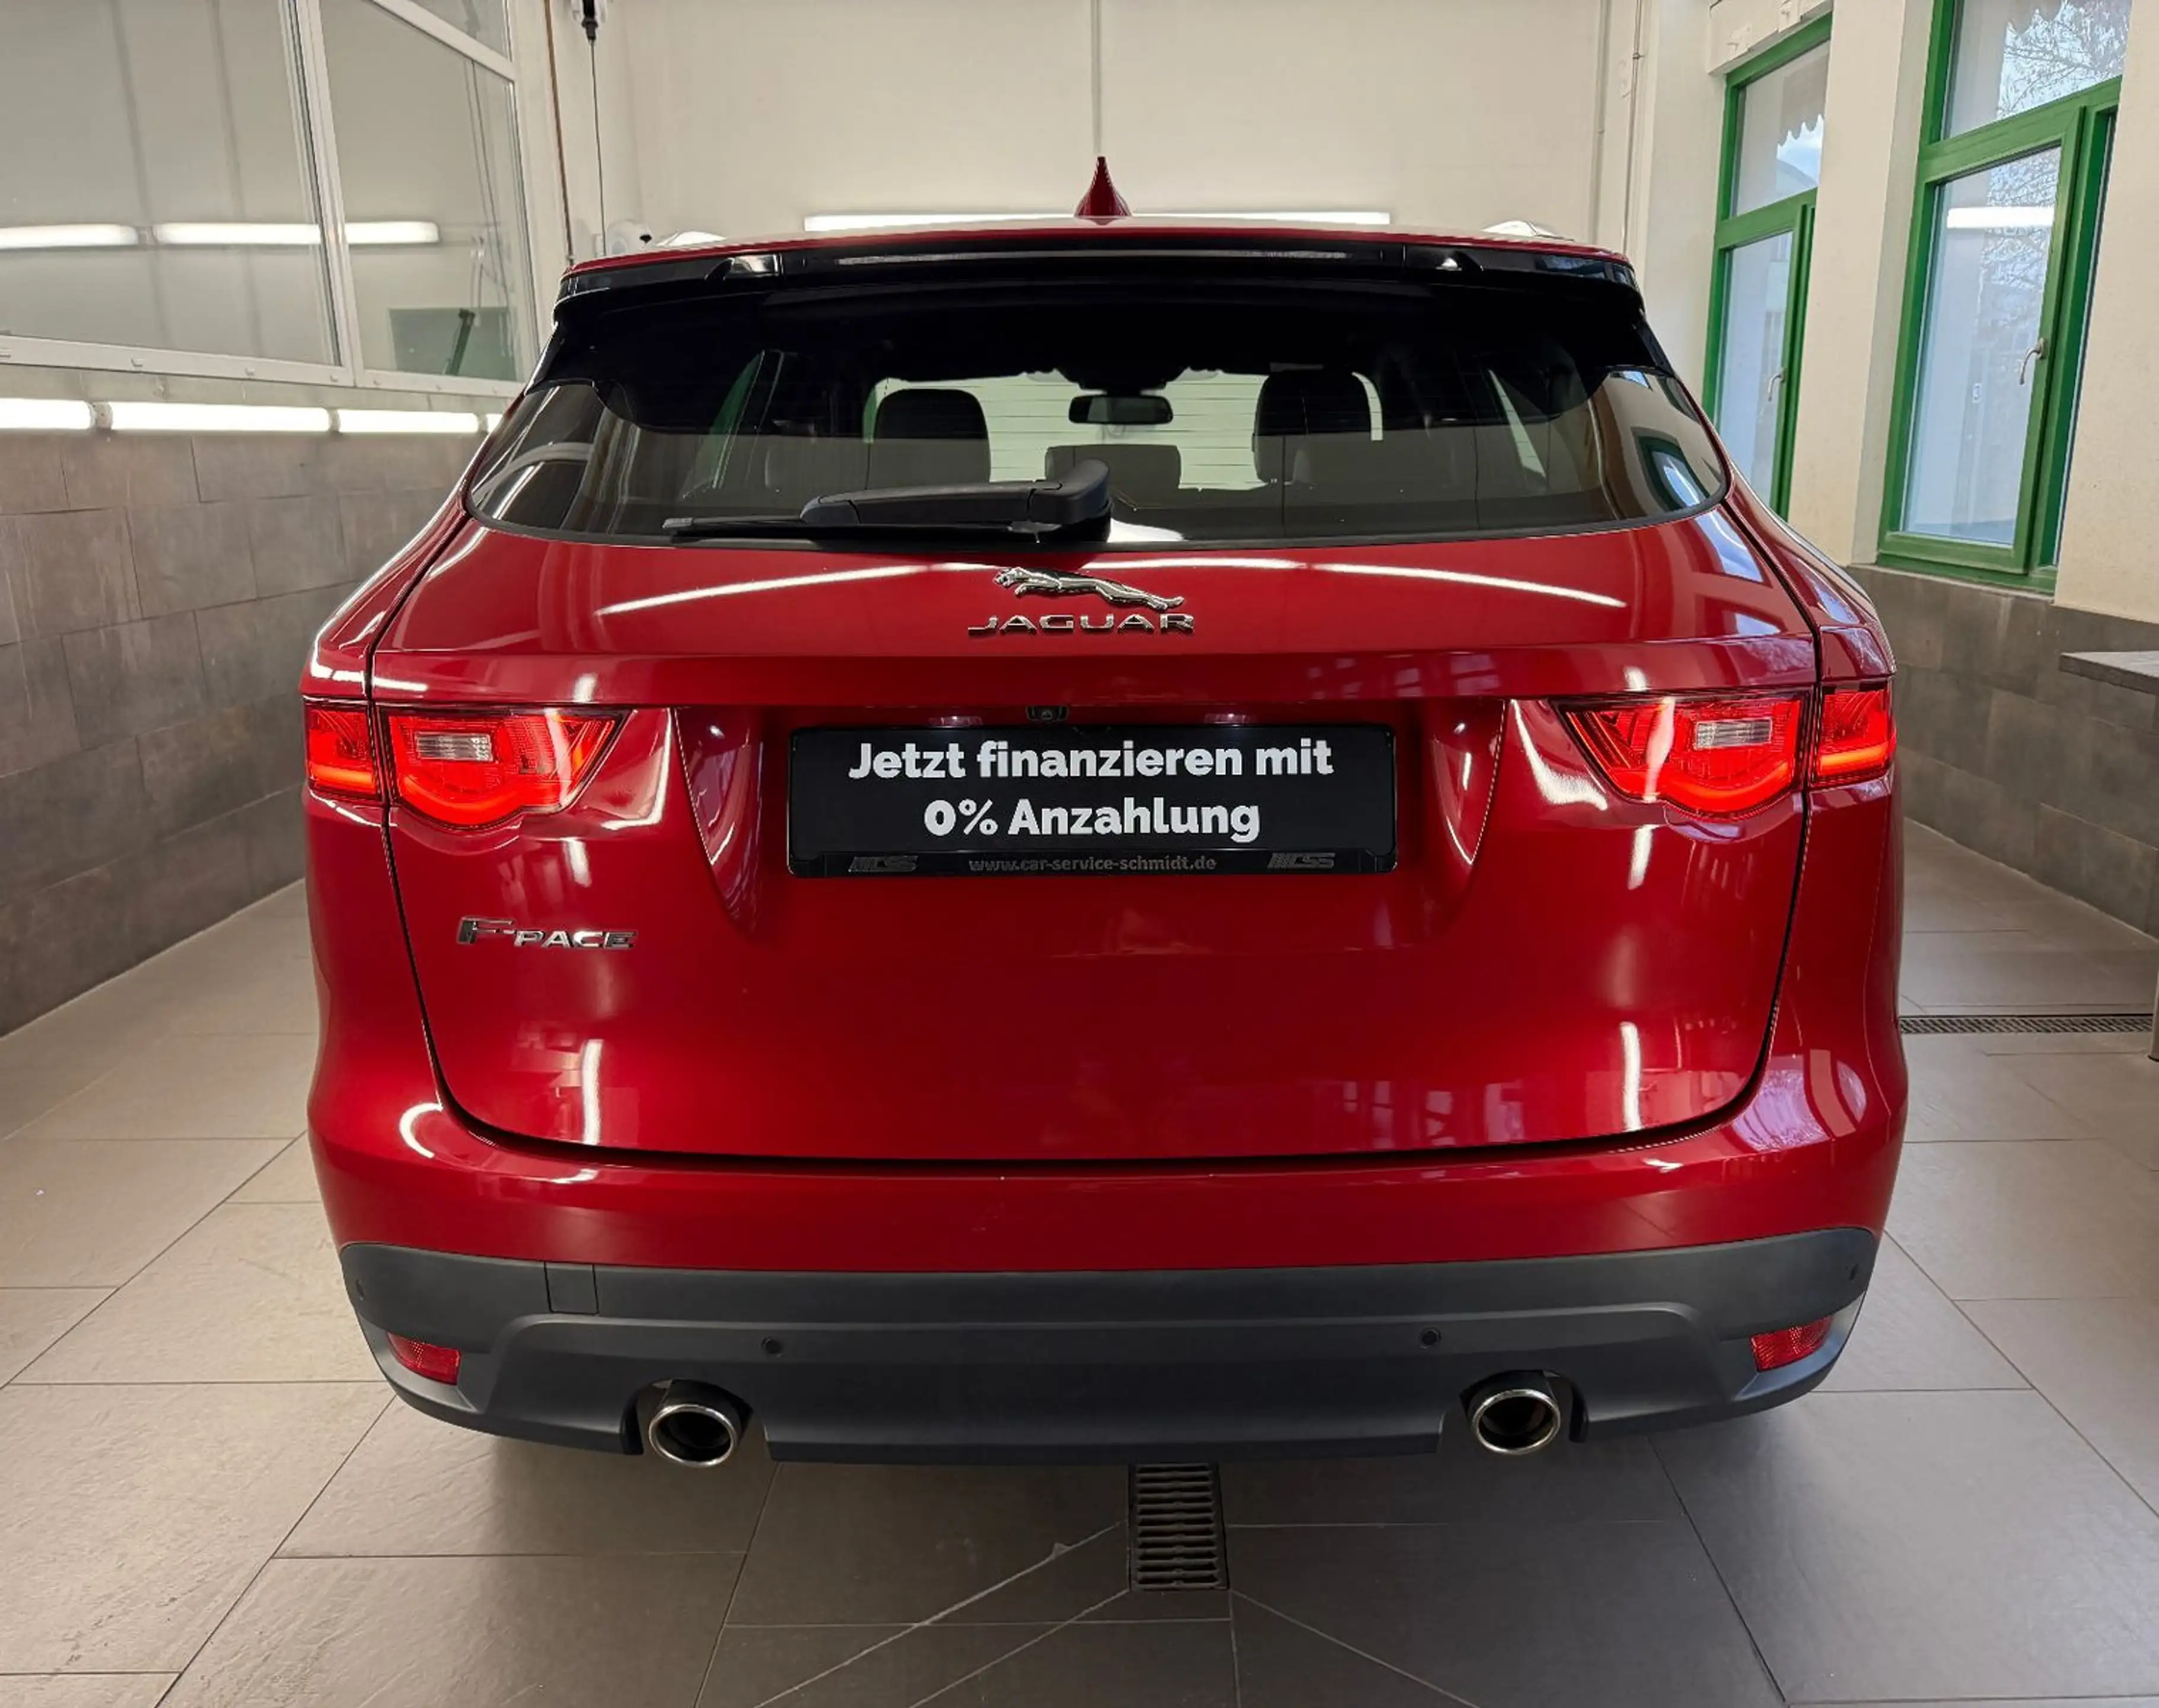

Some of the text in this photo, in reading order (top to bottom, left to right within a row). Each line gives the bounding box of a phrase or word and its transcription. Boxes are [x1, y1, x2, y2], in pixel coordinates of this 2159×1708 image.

[968, 613, 1194, 635] JAGUAR
[848, 738, 1334, 779] Jetzt finanzieren mit
[924, 796, 1260, 843] 0% Anzahlung
[969, 854, 1217, 871] www.car-service-schmidt.de
[457, 916, 638, 950] F-PACE
